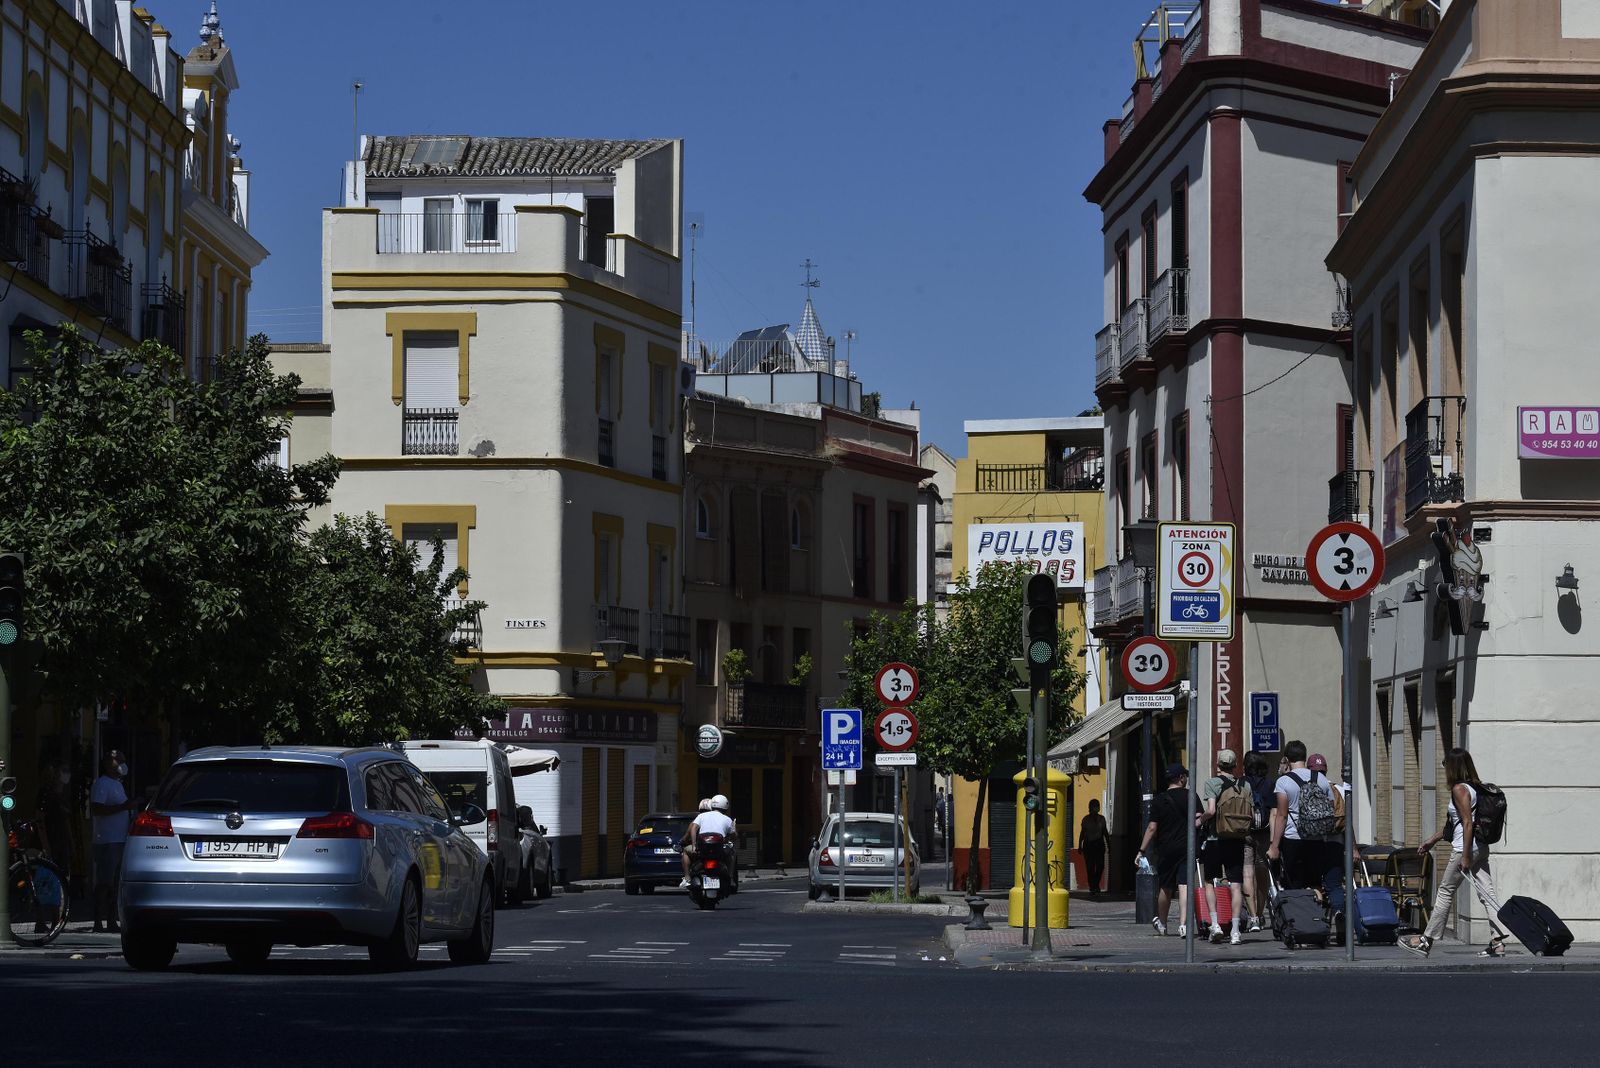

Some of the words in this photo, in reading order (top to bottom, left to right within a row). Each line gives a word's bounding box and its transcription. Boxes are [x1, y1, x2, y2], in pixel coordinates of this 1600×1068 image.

[1542, 440, 1558, 449] 954
[1560, 440, 1572, 449] 53
[1573, 440, 1585, 449] 40
[1586, 440, 1598, 449] 40
[1169, 528, 1227, 539] ATENCIÓN
[978, 529, 1073, 556] POLLOS
[1182, 542, 1211, 551] ZONA
[1254, 554, 1280, 566] MURO
[1285, 556, 1298, 567] DE
[1186, 562, 1207, 576] 30
[1262, 568, 1309, 581] NAVARRO
[505, 620, 547, 628] TINTES
[1134, 654, 1164, 673] 30
[1258, 700, 1273, 724] P
[487, 729, 529, 737] TRESILLOS
[830, 713, 854, 745] P
[884, 721, 904, 736] 1,9
[825, 752, 836, 760] 24
[837, 752, 844, 760] H
[207, 841, 239, 852] 1957
[247, 842, 275, 853] HPW
